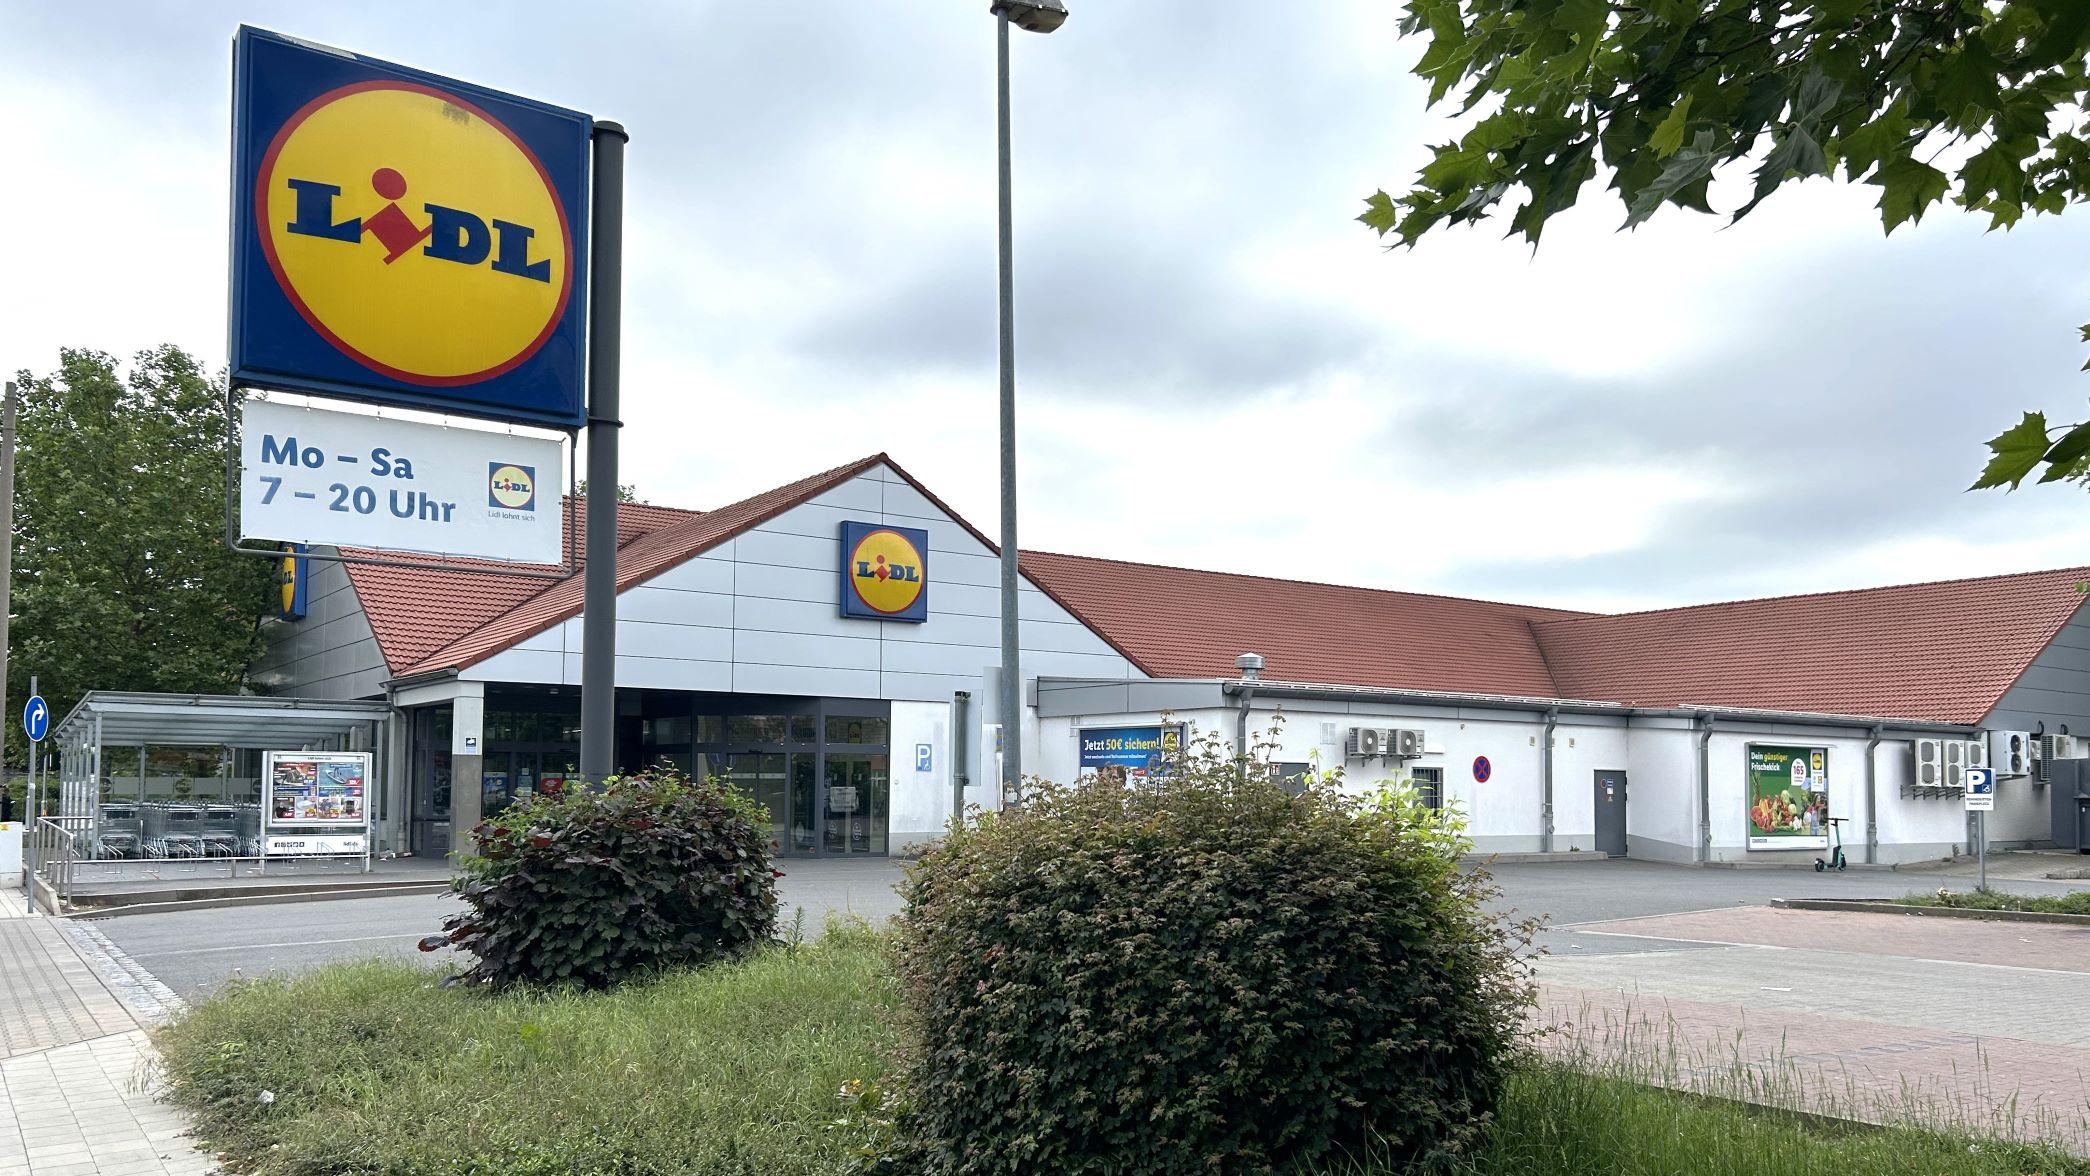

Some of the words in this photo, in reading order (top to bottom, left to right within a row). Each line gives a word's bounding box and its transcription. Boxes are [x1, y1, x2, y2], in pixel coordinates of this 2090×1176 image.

[261, 434, 325, 469] Mo
[371, 447, 414, 480] Sa
[259, 476, 282, 505] 7
[328, 483, 377, 515] 20
[389, 489, 456, 522] Uhr
[488, 510, 501, 518] Lidl
[502, 512, 520, 521] lohnt
[1084, 739, 1104, 751] Jetzt
[1106, 739, 1123, 750] 50€
[1125, 737, 1159, 750] sichern!
[917, 744, 931, 768] P
[1751, 752, 1763, 760] Dein
[1764, 752, 1788, 763] günstiger
[1751, 762, 1780, 771] Frischekick
[1793, 765, 1804, 776] 165
[1966, 770, 1986, 793] P
